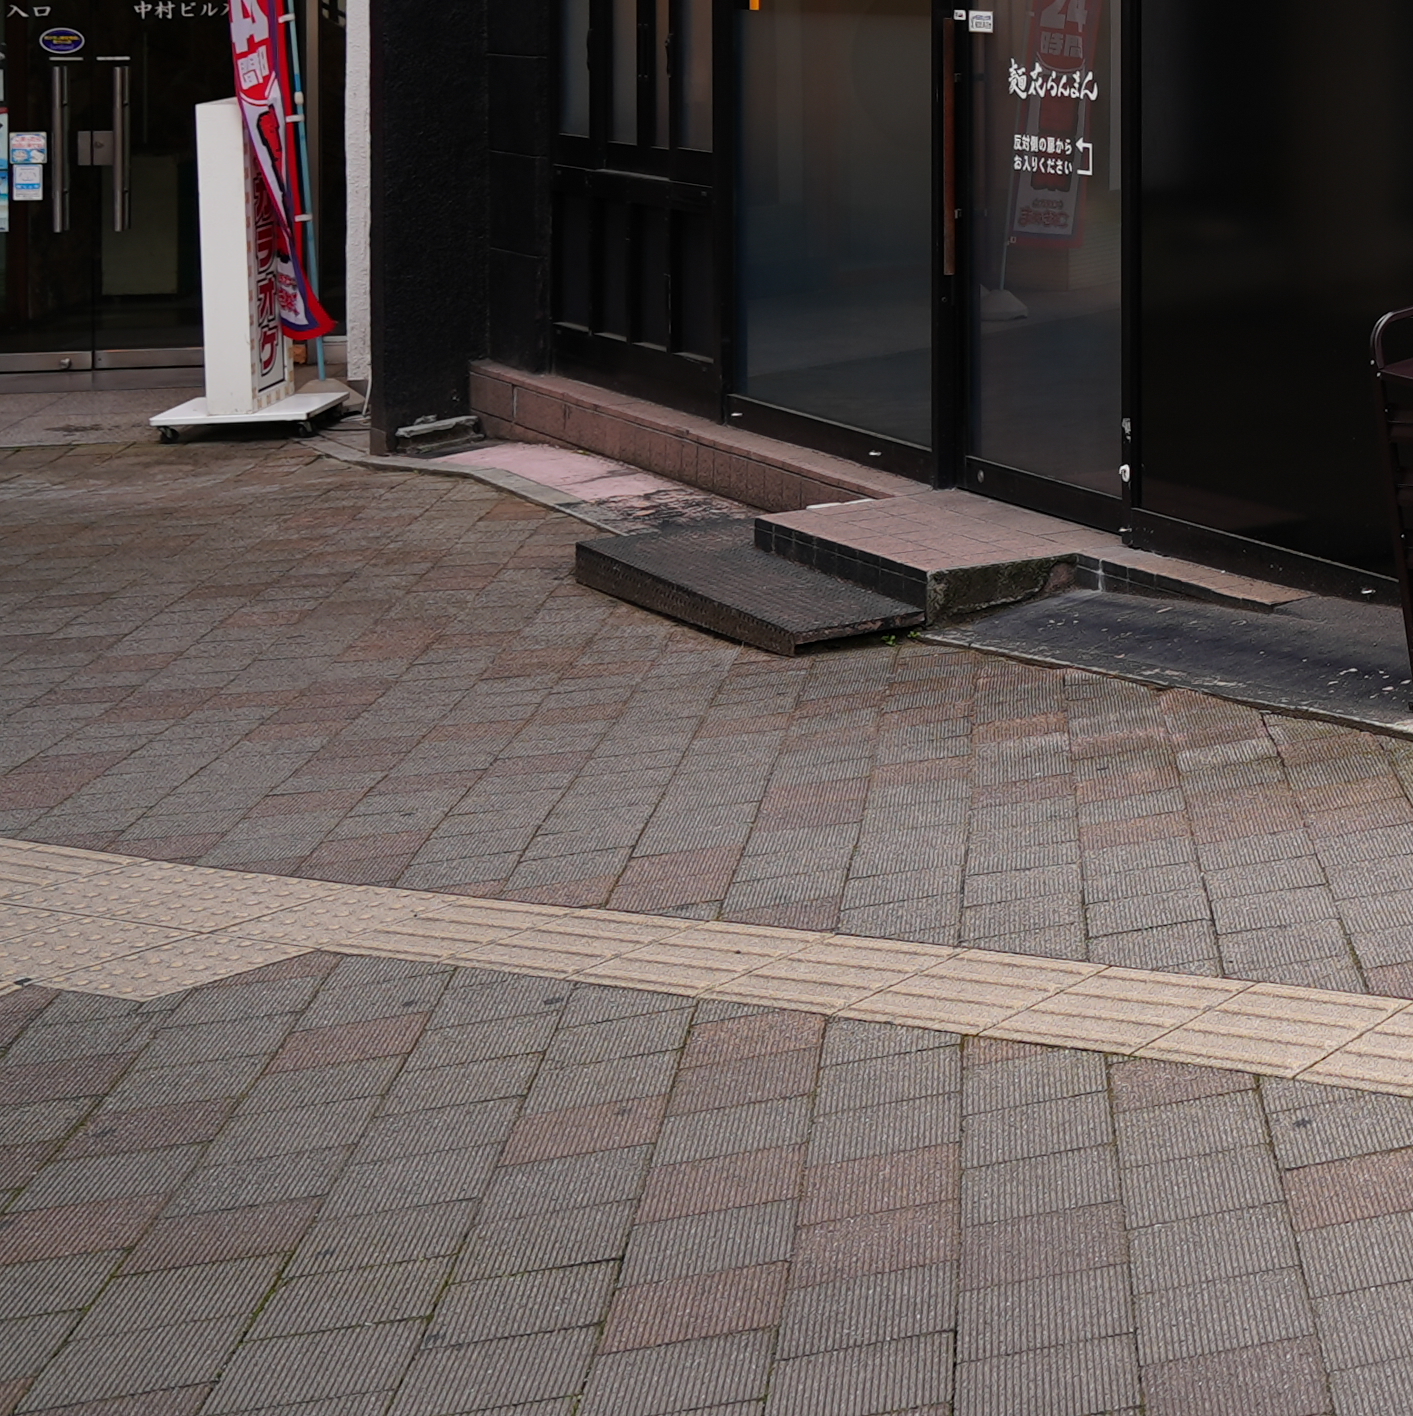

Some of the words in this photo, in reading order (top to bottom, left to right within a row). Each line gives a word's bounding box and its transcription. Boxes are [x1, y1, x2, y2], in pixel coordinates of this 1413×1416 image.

[1008, 58, 1098, 100] 麺花らんまん
[1013, 134, 1072, 155] 反対側の扉から
[1013, 155, 1073, 175] お入りください
